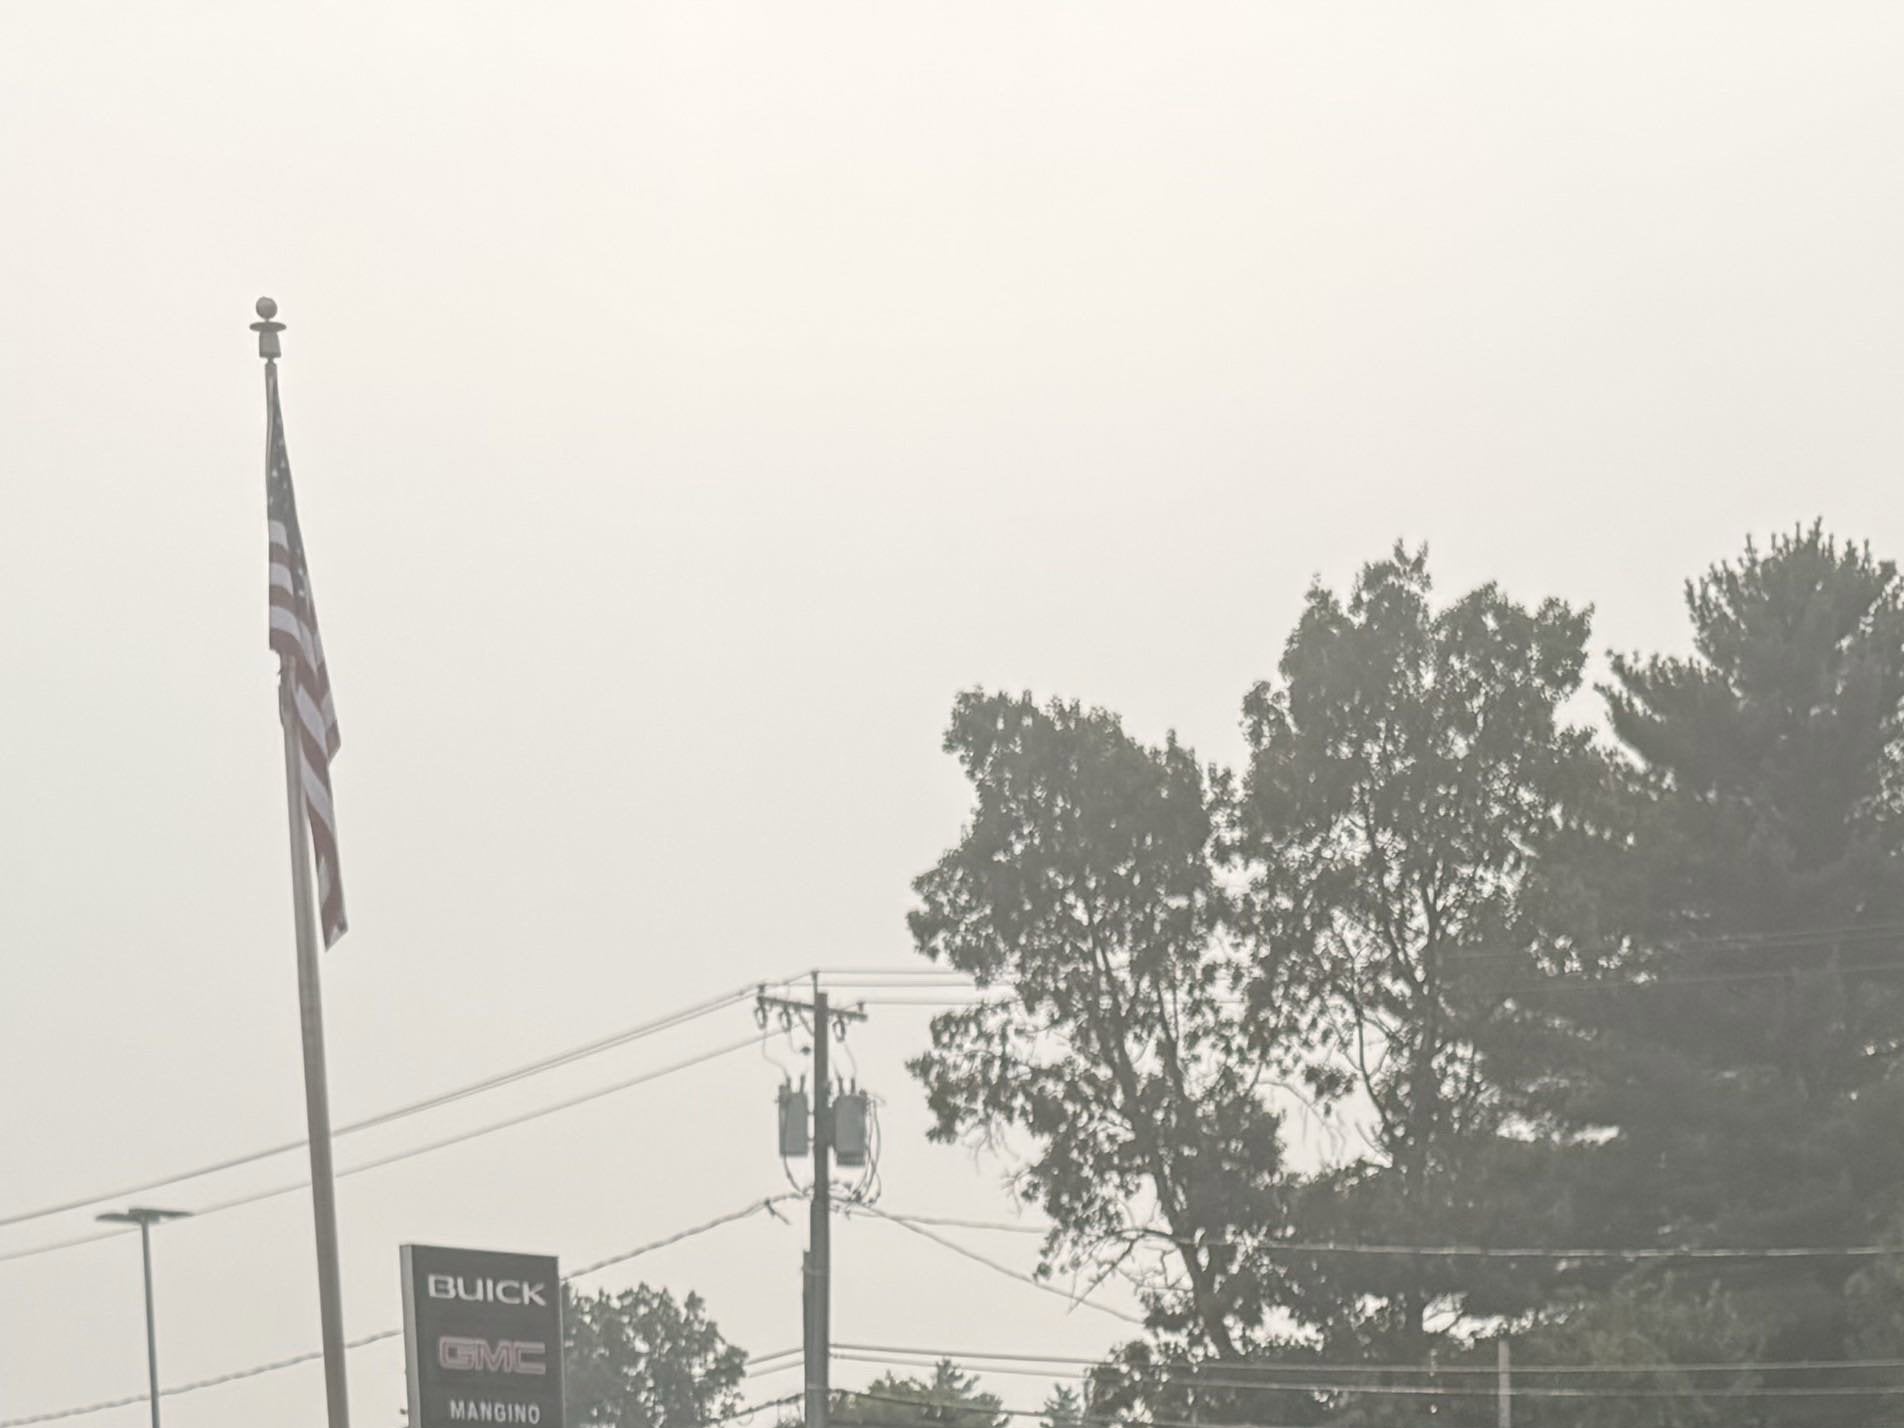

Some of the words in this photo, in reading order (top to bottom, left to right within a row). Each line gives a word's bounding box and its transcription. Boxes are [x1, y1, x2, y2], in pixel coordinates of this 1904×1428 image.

[427, 1273, 547, 1306] BUICK
[439, 1336, 546, 1375] GMC
[449, 1400, 541, 1424] MANGINO
